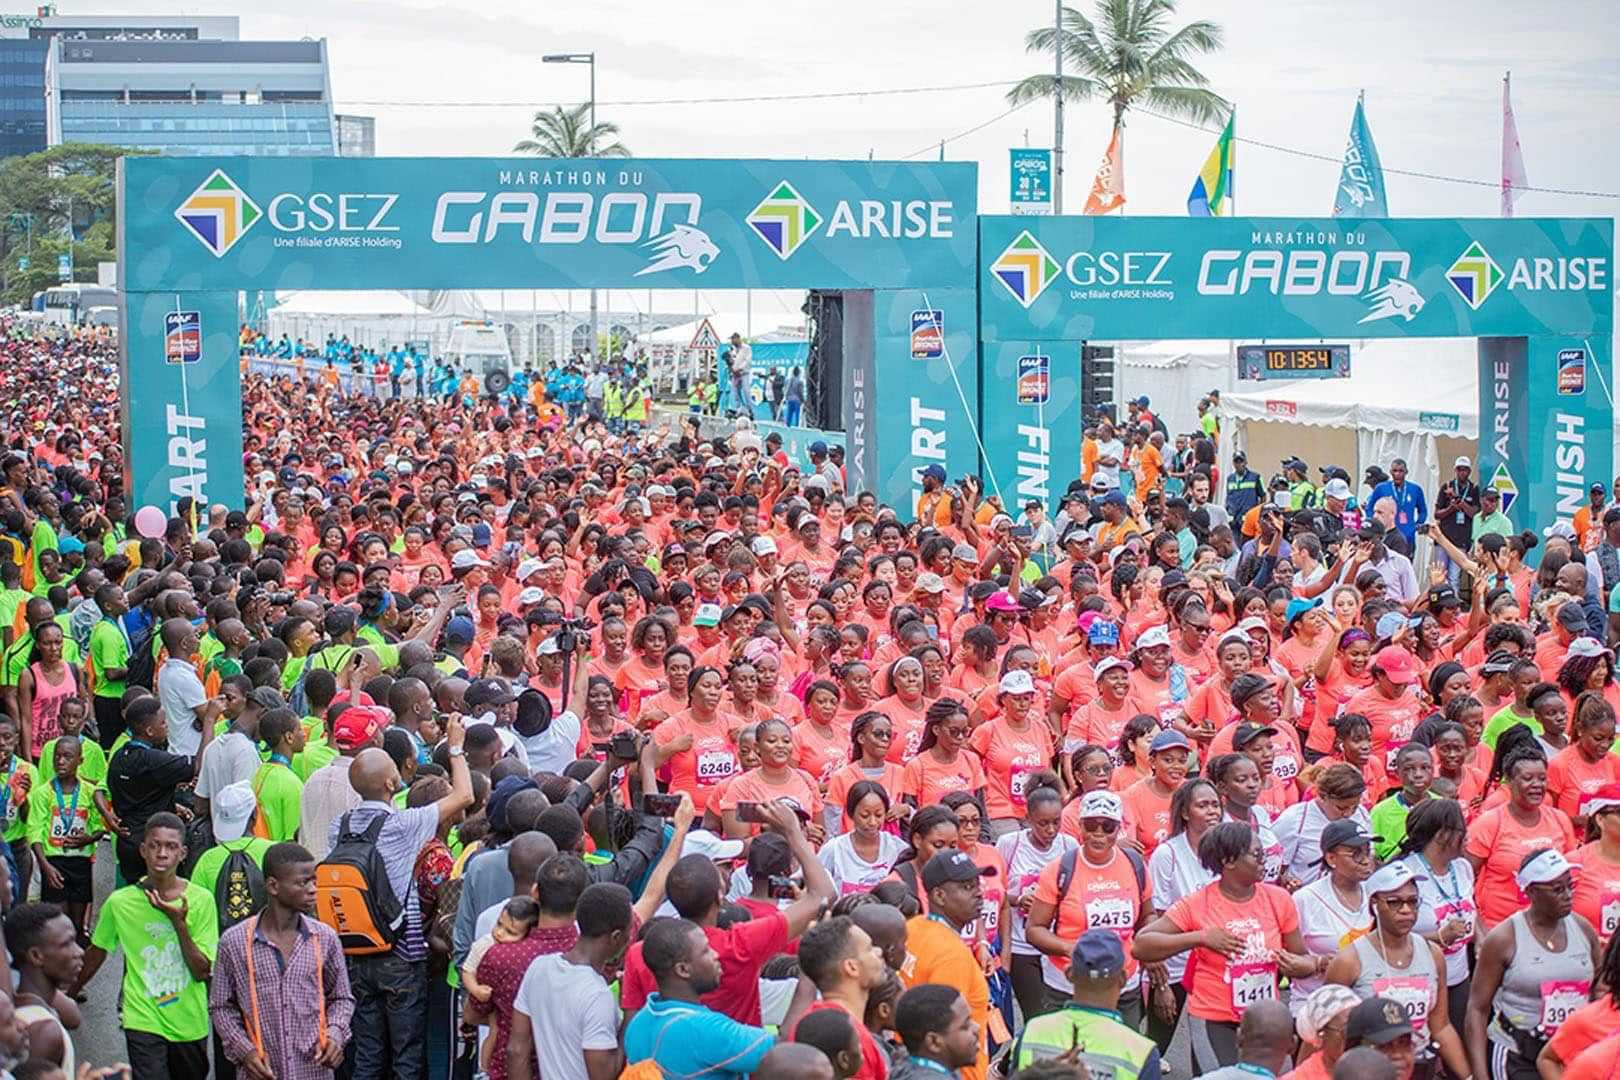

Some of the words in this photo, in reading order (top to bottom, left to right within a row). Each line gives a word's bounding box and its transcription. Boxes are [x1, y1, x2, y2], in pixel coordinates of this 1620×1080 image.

[500, 171, 606, 185] MARATHON
[620, 171, 643, 185] DU
[268, 192, 401, 232] GSEZ
[431, 191, 703, 244] GABON
[825, 200, 953, 238] ARISE
[273, 238, 294, 248] Une
[296, 237, 322, 248] filiale
[324, 237, 361, 248] d'ARISE
[362, 237, 402, 250] Holding
[1251, 232, 1337, 245] MARATHON
[1346, 232, 1366, 245] DU
[1065, 251, 1173, 286] GSEZ
[1197, 250, 1411, 296] GABON
[1507, 257, 1607, 290] ARISE
[1070, 290, 1088, 300] Une
[1142, 289, 1174, 301] Holding
[853, 368, 865, 476] ARISE
[1493, 361, 1510, 460] ARISE
[1556, 413, 1585, 523] NISH
[700, 762, 731, 775] 6246
[981, 911, 997, 925] 76
[1090, 910, 1131, 927] 2475
[1238, 984, 1272, 1003] 1411
[1405, 1001, 1426, 1017] 03
